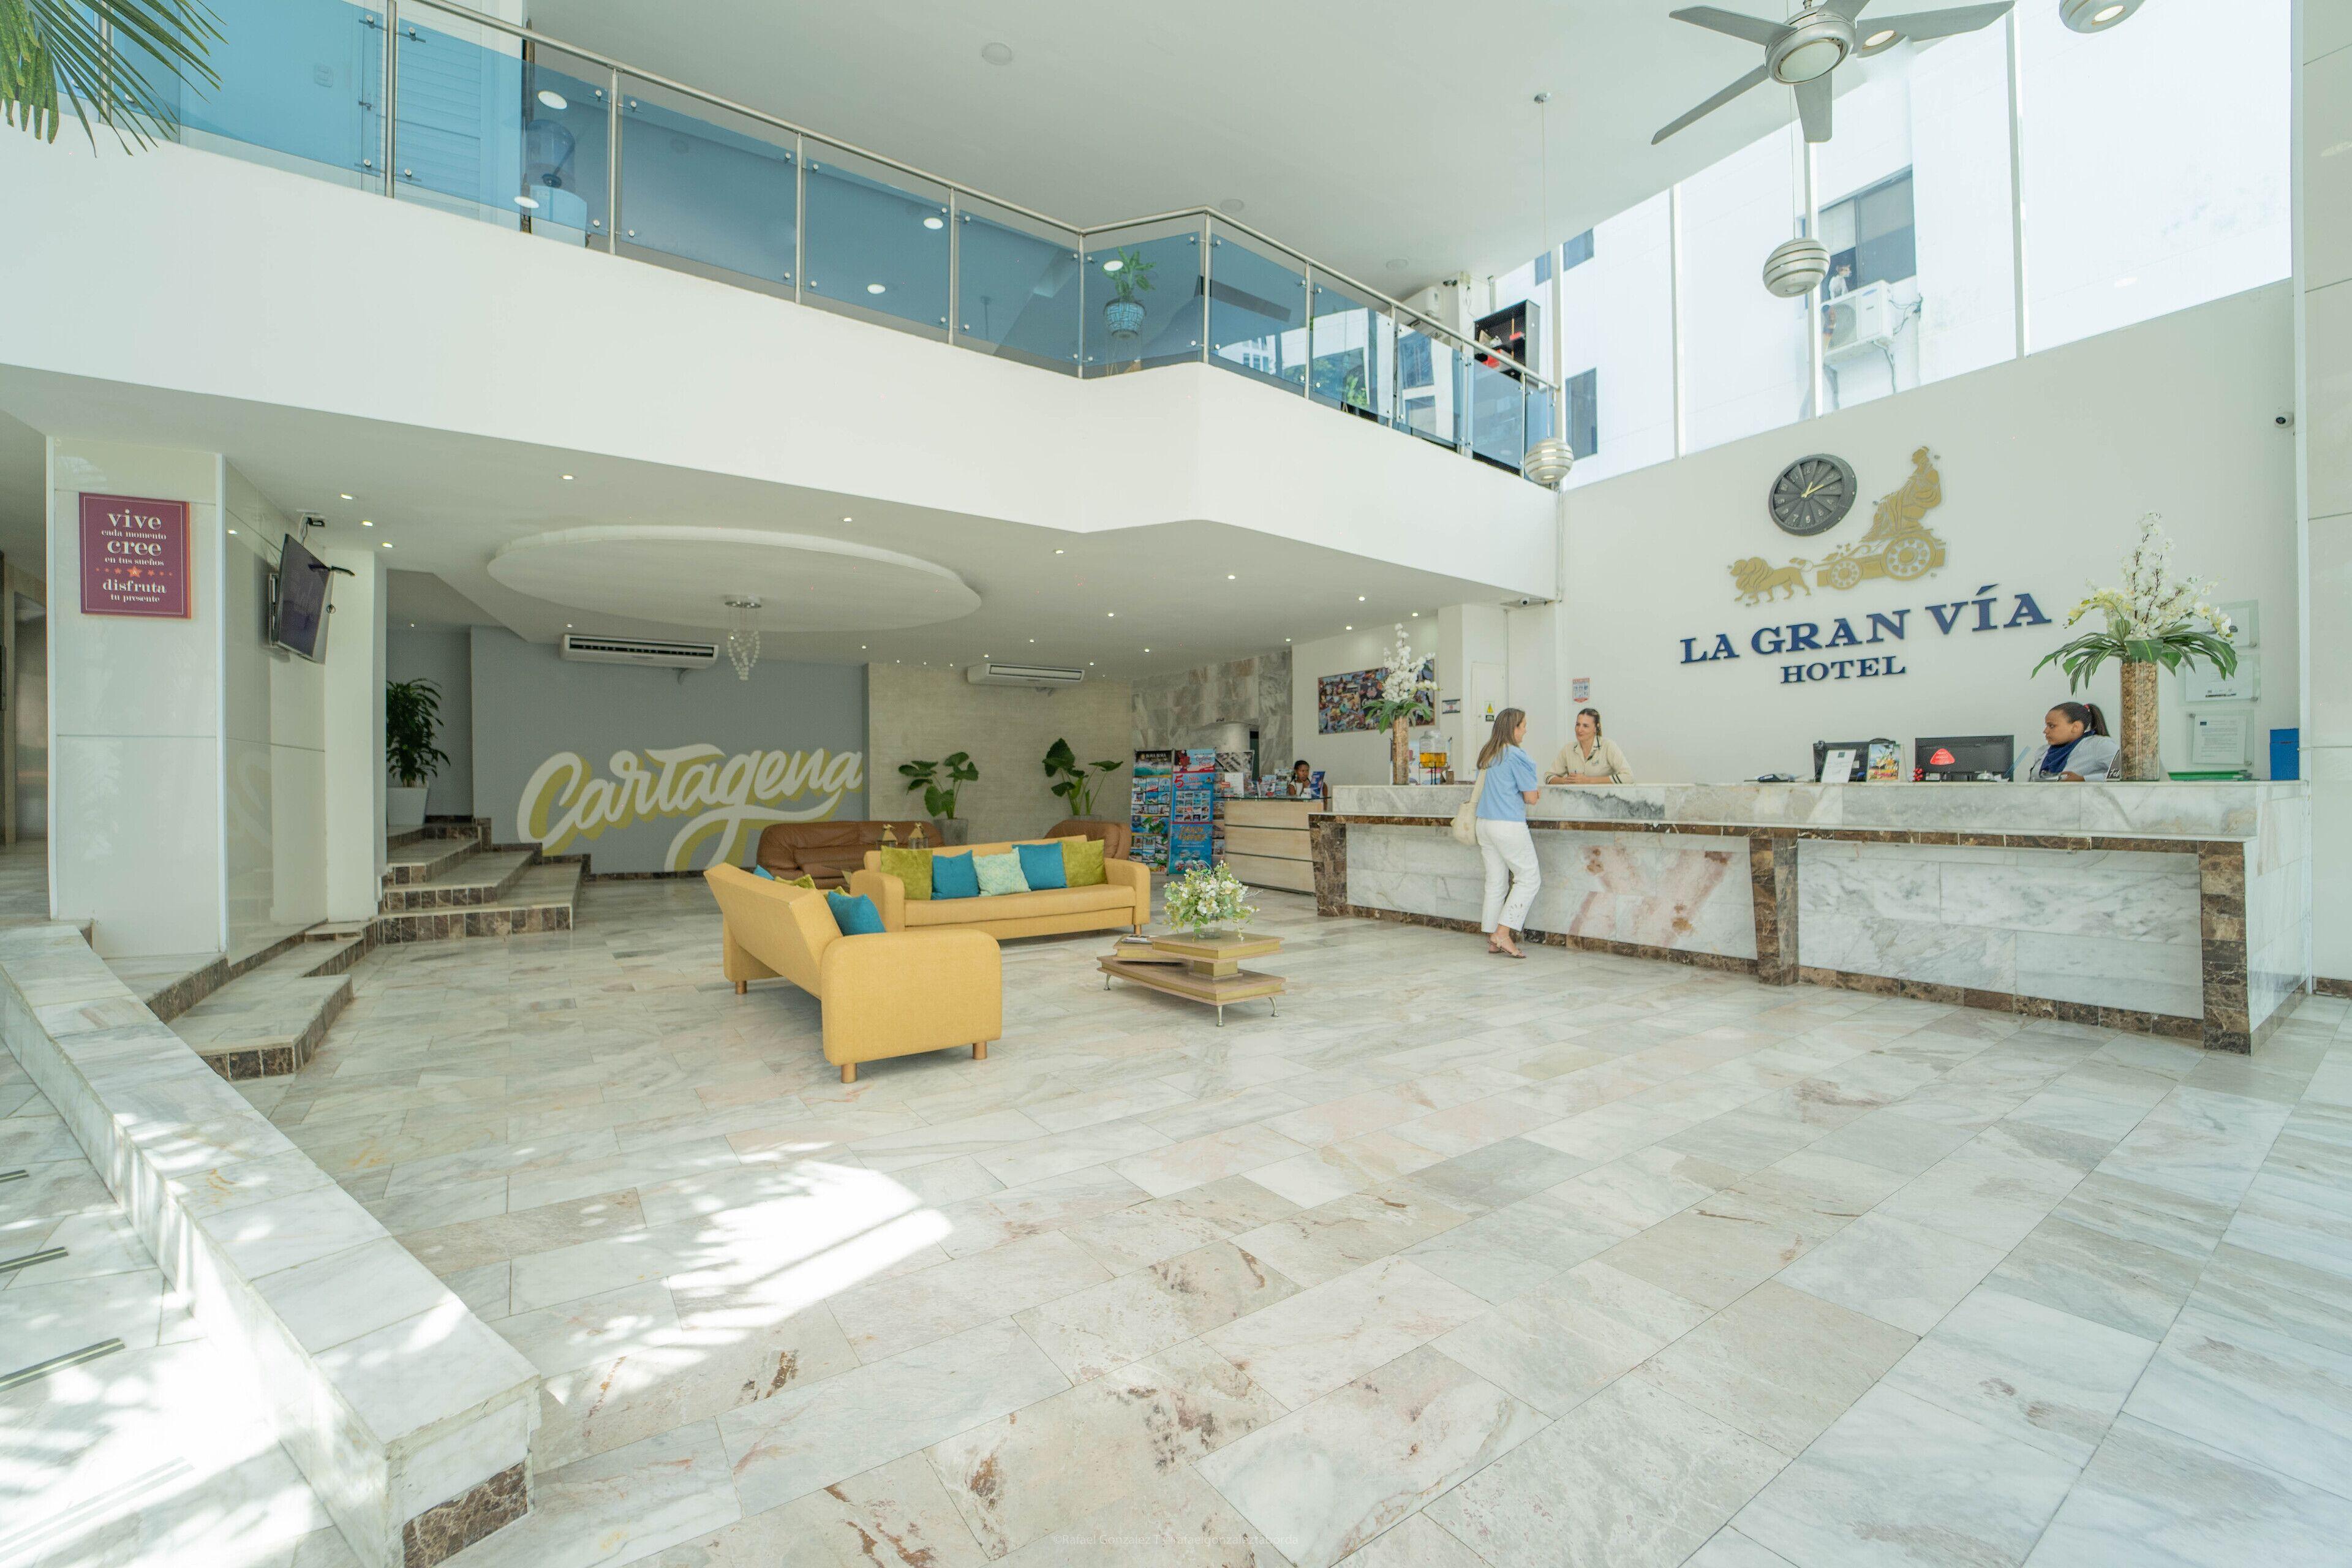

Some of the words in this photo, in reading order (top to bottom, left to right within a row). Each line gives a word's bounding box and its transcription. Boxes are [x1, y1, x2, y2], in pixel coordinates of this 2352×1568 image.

[107, 508, 162, 530] vive
[101, 529, 123, 537] cada
[126, 531, 167, 540] momento
[107, 540, 162, 557] cree
[102, 578, 167, 594] disfruta
[1679, 634, 1740, 665] LA
[1751, 609, 1912, 656] GRAN
[1924, 583, 2052, 635] VÍA
[1779, 655, 1907, 685] HOTEL
[1174, 774, 1184, 789] 5
[516, 743, 864, 872] Cartagena
